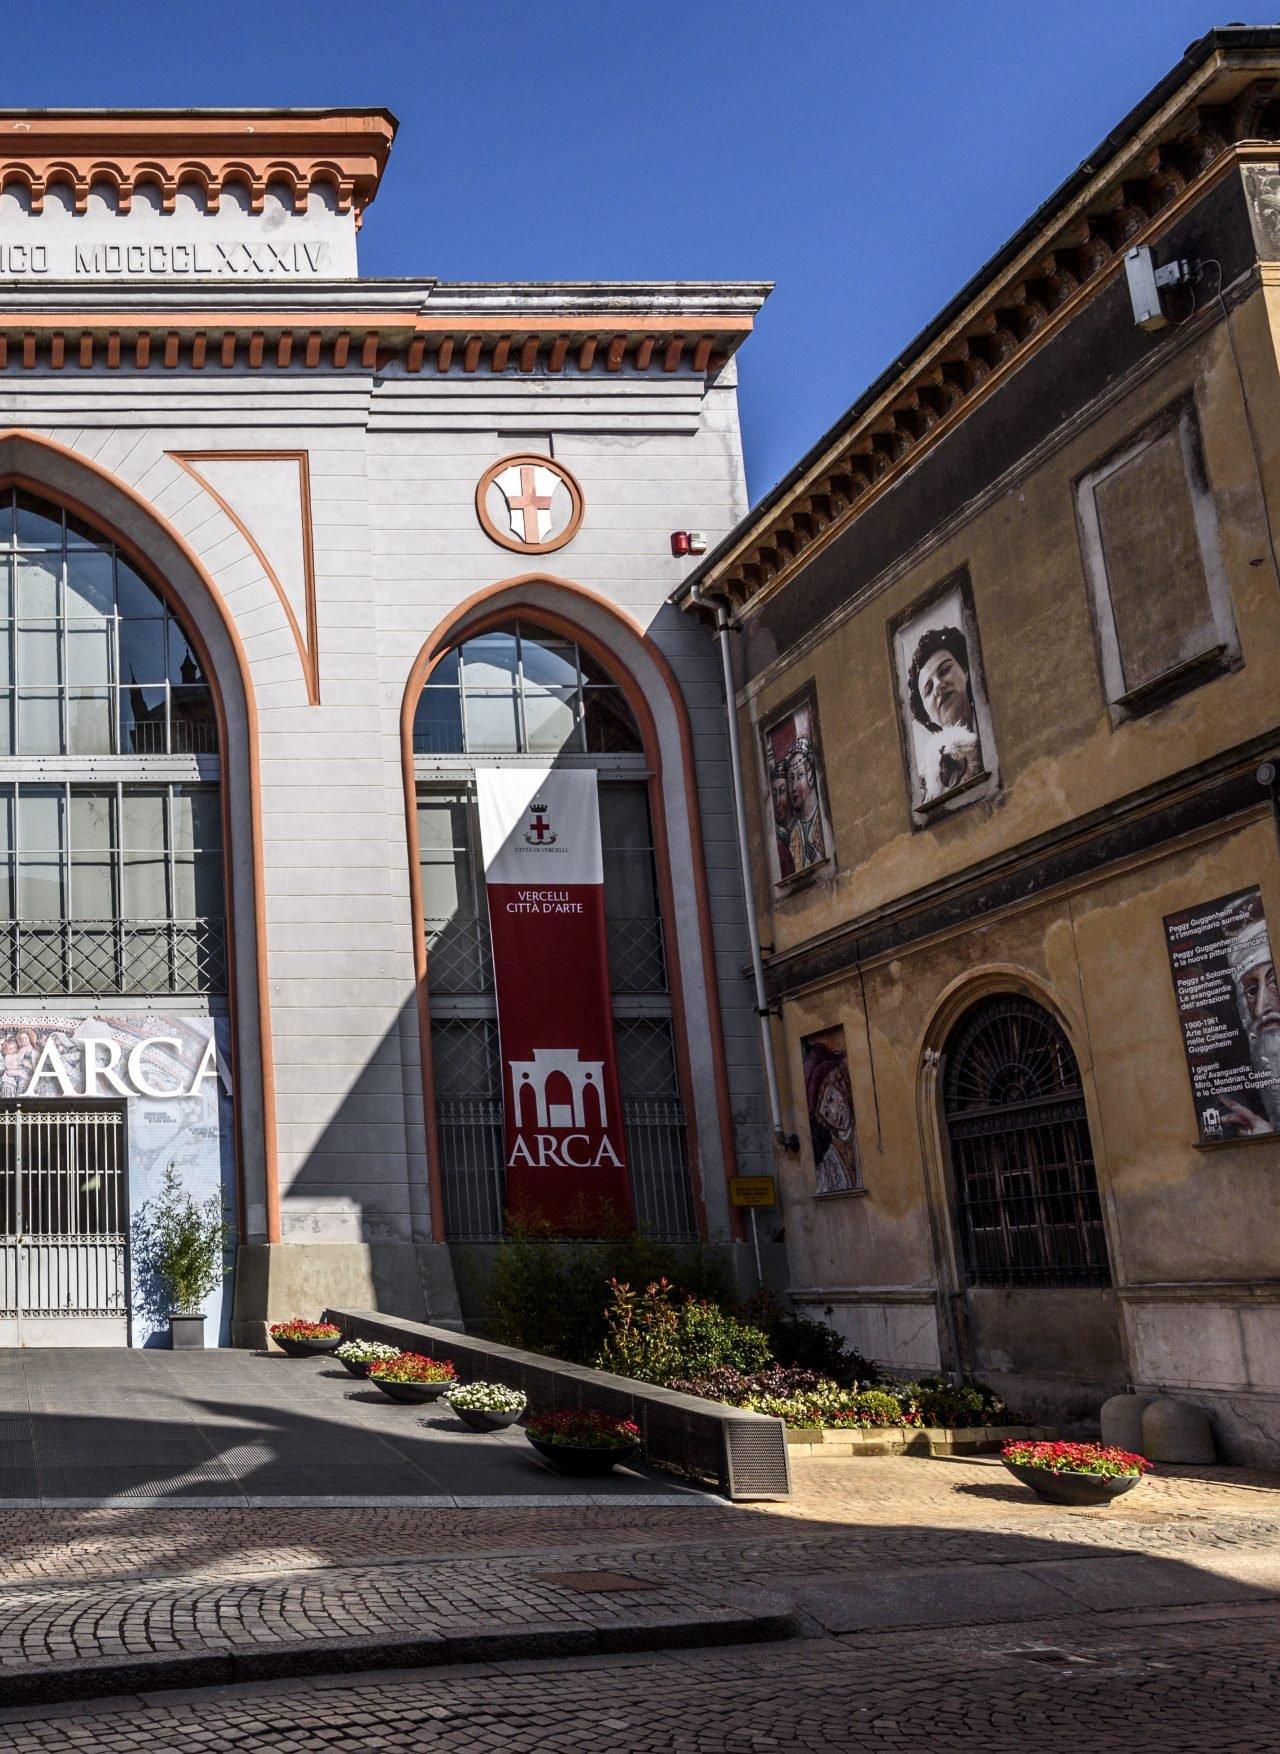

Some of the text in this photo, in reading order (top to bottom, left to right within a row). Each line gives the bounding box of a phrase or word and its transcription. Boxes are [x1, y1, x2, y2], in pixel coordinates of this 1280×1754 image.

[74, 243, 323, 273] MDCCCLXXXIV
[517, 891, 569, 901] VERCELLI
[506, 900, 584, 913] CITTÀ D'ARTE
[1169, 923, 1189, 933] Peggy
[1190, 908, 1233, 926] Guggenheim
[1176, 921, 1220, 939] l'immaginario
[1222, 911, 1250, 925] surreale
[1173, 950, 1194, 960] Peggy
[1195, 937, 1238, 954] Guggenheim
[1188, 954, 1208, 963] nuova
[1209, 946, 1231, 959] pittura
[1233, 936, 1267, 951] americana
[1177, 977, 1199, 987] Peggy
[1206, 966, 1236, 980] Solomon
[1178, 979, 1224, 995] Guggenheim:
[1190, 985, 1232, 1000] avanguardie
[1181, 993, 1230, 1010] dell'astrazione
[1184, 1016, 1219, 1030] 1900-1961
[1186, 1024, 1227, 1038] Arte italiana
[1187, 1028, 1239, 1046] nelle Collezioni
[1188, 1040, 1232, 1054] Guggenheim
[21, 1036, 233, 1097] ARCA
[1196, 1062, 1220, 1074] giganti
[1214, 1075, 1248, 1086] Mondrian,
[1248, 1070, 1272, 1080] Calder
[1210, 1084, 1244, 1095] Collezioni
[507, 1133, 625, 1167] ARCA
